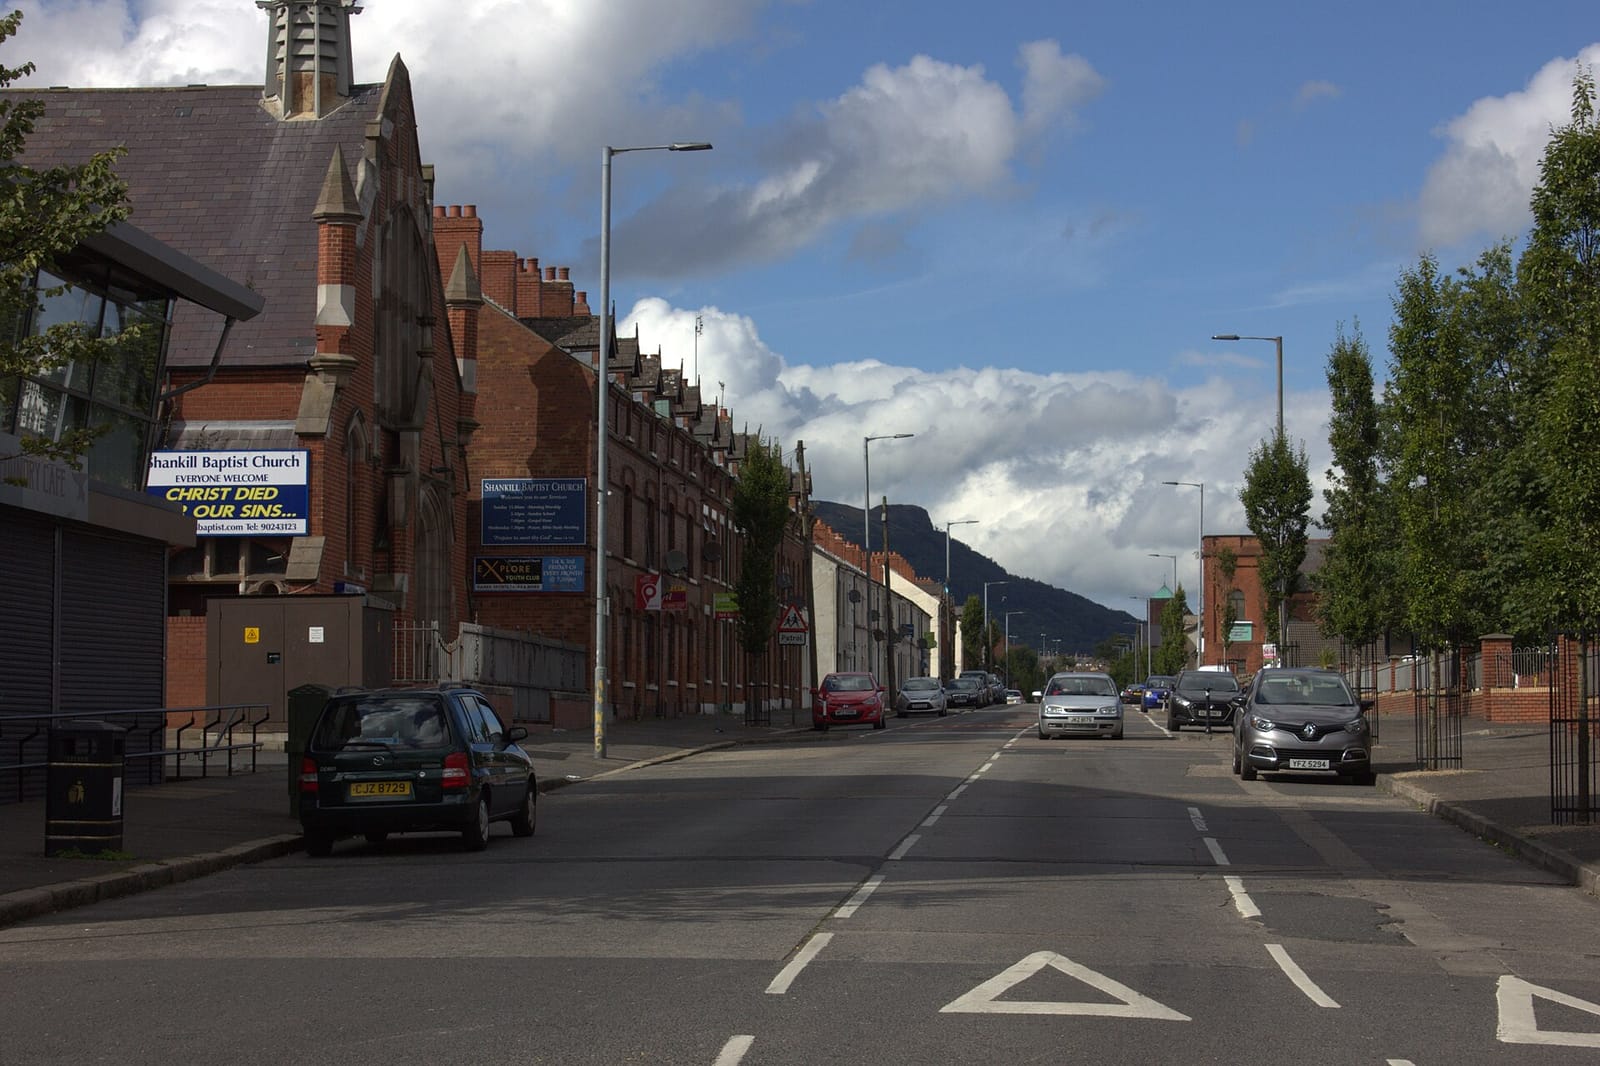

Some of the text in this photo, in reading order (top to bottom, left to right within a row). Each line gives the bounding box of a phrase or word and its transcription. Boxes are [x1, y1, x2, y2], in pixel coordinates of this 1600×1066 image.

[149, 454, 300, 473] Shankill Baptist Church
[175, 473, 270, 483] EVERYONE WELCOME
[484, 482, 584, 492] SHANKILL BAPTIST CHURCH
[165, 487, 280, 502] CHRIST DIED
[193, 504, 236, 519] OUR
[239, 503, 297, 518] SINS...
[246, 523, 259, 532] Tel:
[261, 522, 297, 532] 90243123
[781, 634, 804, 643] Patrol
[354, 783, 406, 794] CJZ 8729
